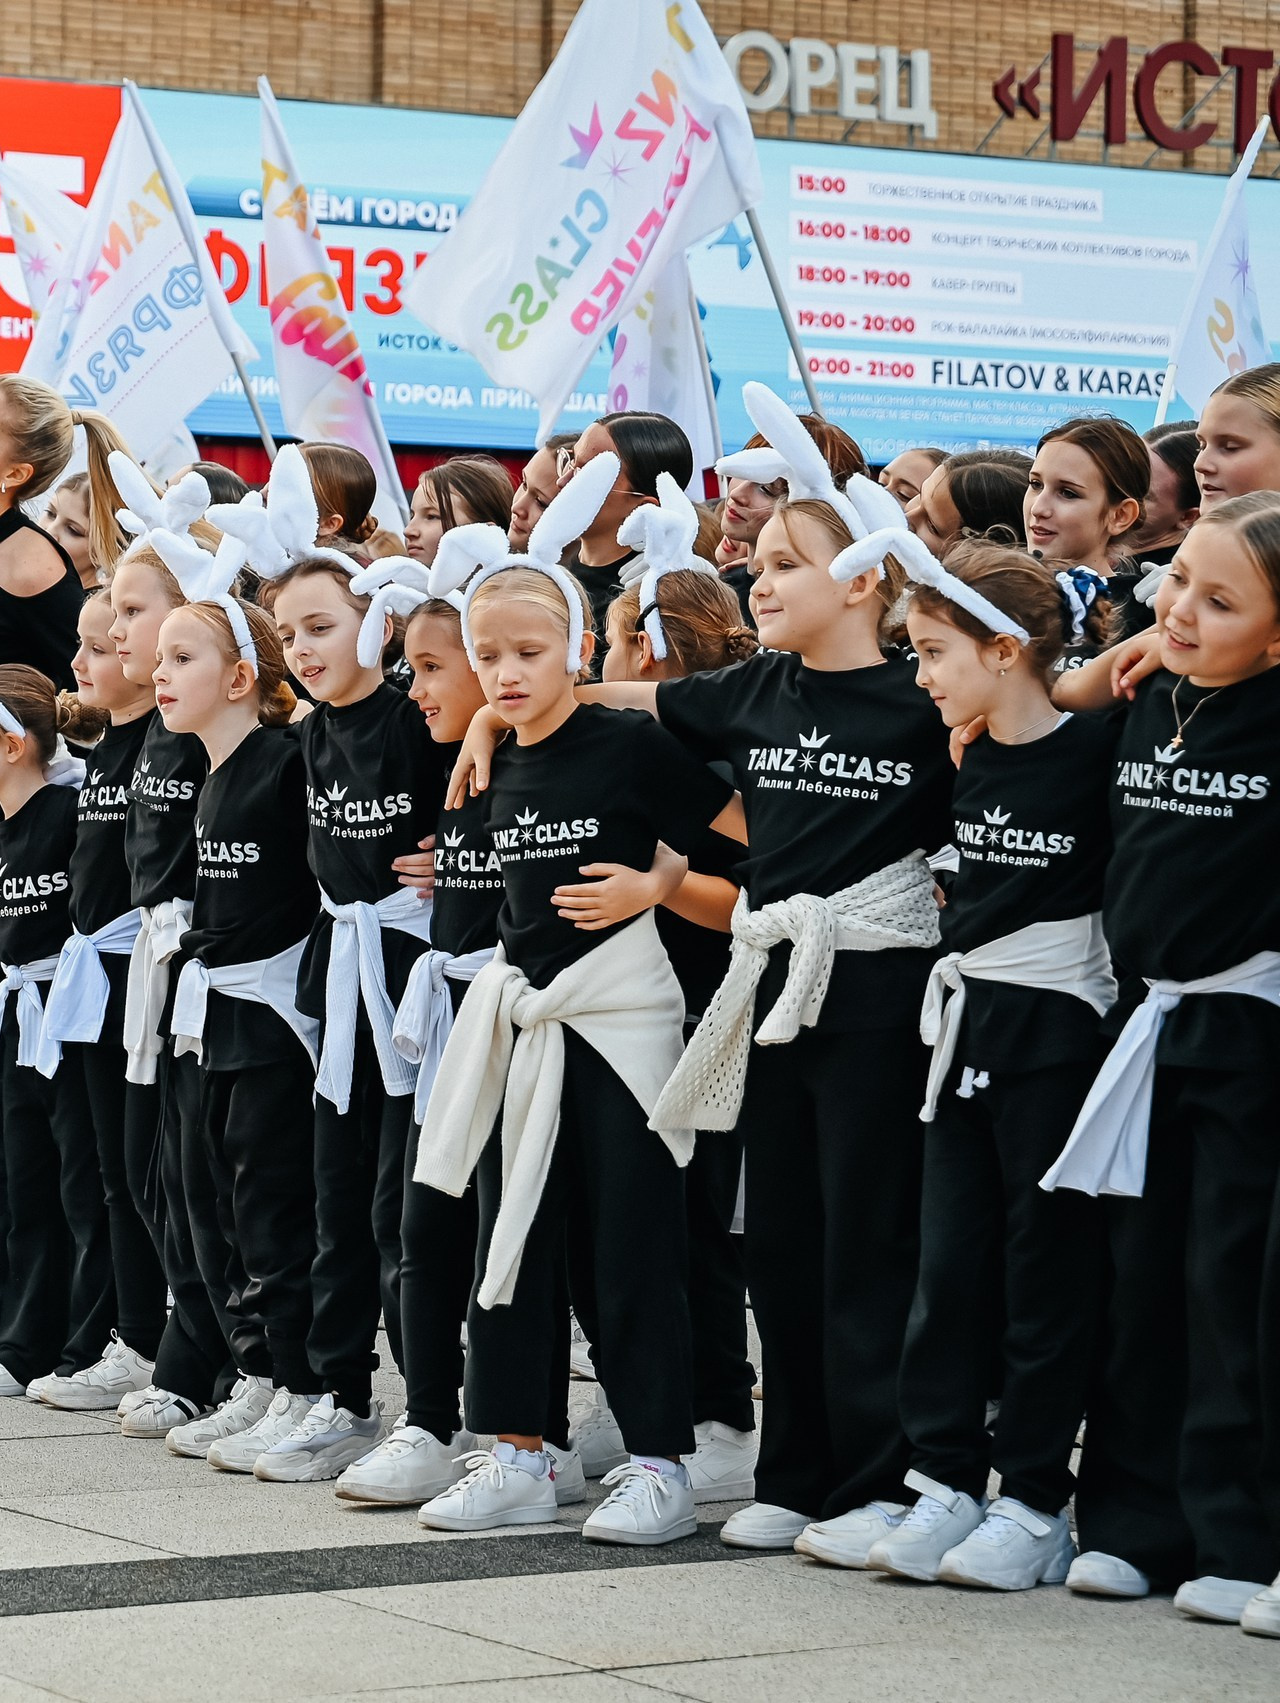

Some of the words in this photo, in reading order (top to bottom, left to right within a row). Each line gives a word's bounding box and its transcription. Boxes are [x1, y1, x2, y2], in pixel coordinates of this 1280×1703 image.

[992, 32, 1280, 154] «ИСТ
[797, 174, 847, 194] 15:00
[867, 181, 966, 203] ТОРЖЕСТВЕННОЕ
[968, 190, 1028, 208] ОТКРЫТИЕ
[1031, 195, 1099, 213] ПРАЗДНИКА
[360, 197, 462, 233] ГОРОД
[797, 218, 846, 240] 16:00
[862, 224, 912, 244] 18:00
[931, 231, 983, 248] КОНЦЕРТ
[1144, 247, 1192, 263] ГОРОДА
[797, 264, 846, 285] 18:00
[862, 269, 912, 289] 19:00
[797, 310, 846, 330] 19:00
[862, 314, 916, 334] 20:00
[378, 332, 443, 352] ИСТОК
[806, 356, 851, 375] 0:00
[868, 360, 916, 379] 21:00
[930, 360, 1047, 390] FILATOV
[1054, 367, 1070, 392] &
[1078, 368, 1166, 397] KARAS
[384, 381, 475, 409] ГОРОДА
[746, 746, 799, 773] TANZ
[818, 751, 915, 787] CLASS
[1116, 760, 1155, 790] ANZ
[1172, 767, 1271, 800] CLASS
[142, 775, 196, 801] CLASS
[756, 775, 793, 791] Лилии
[794, 778, 880, 801] Лебедевой
[343, 792, 413, 824] CLASS
[1150, 796, 1235, 818] Лебедевой
[535, 818, 601, 845] CLASS
[1001, 828, 1077, 855] CLASS
[199, 839, 261, 864] CLASS
[523, 843, 581, 861] Лебедевой
[2, 870, 69, 901] CLASS
